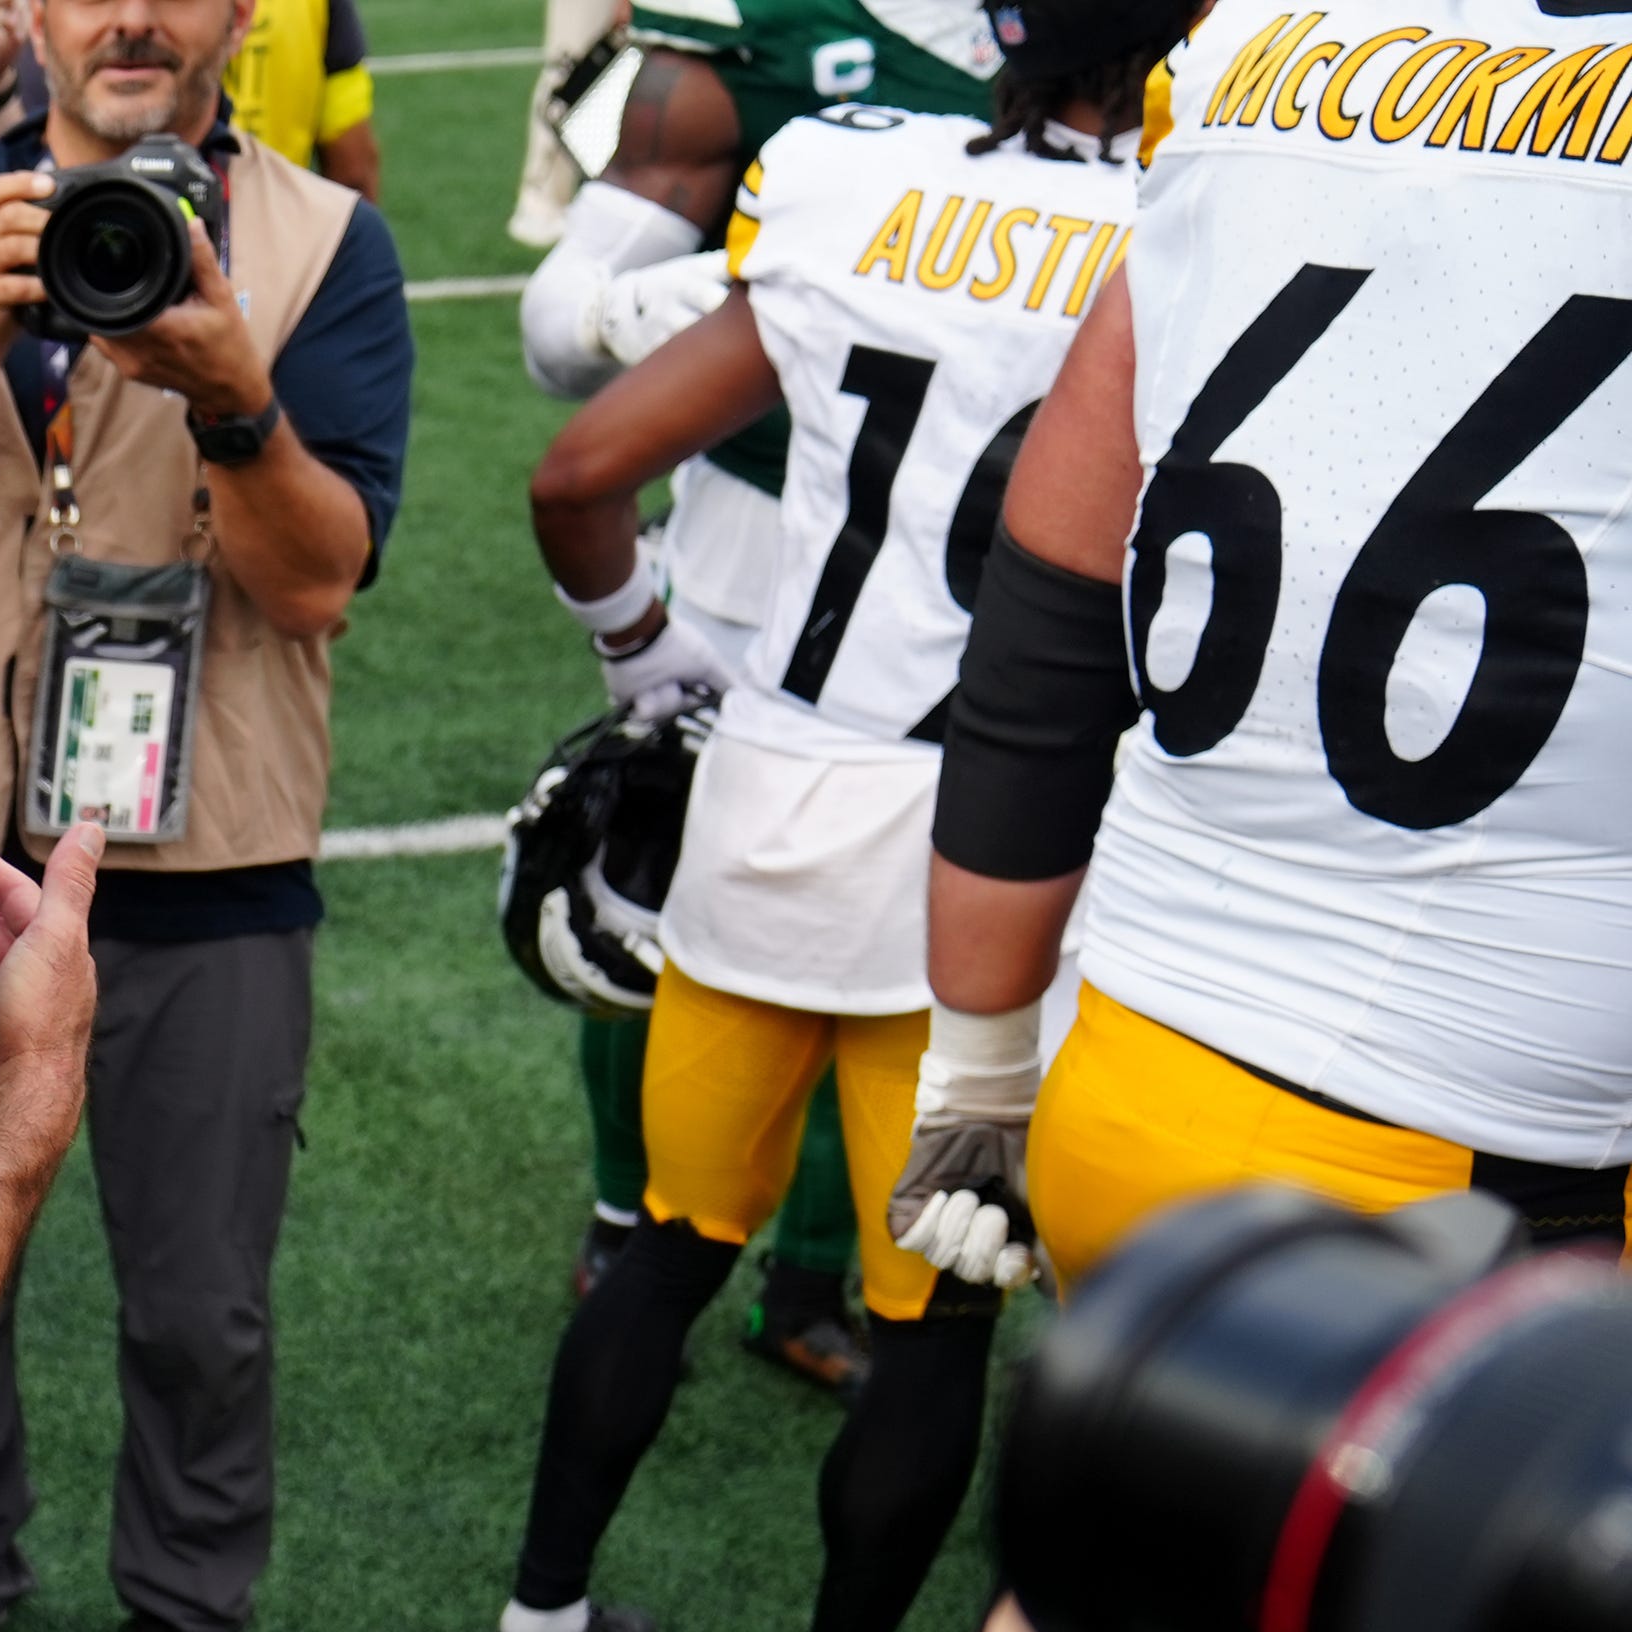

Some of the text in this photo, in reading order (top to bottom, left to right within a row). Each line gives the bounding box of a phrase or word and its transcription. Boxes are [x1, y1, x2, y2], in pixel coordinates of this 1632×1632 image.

[812, 37, 875, 96] C
[130, 155, 175, 172] Canon
[853, 188, 1133, 317] AUSTI
[1130, 262, 1632, 831] 66
